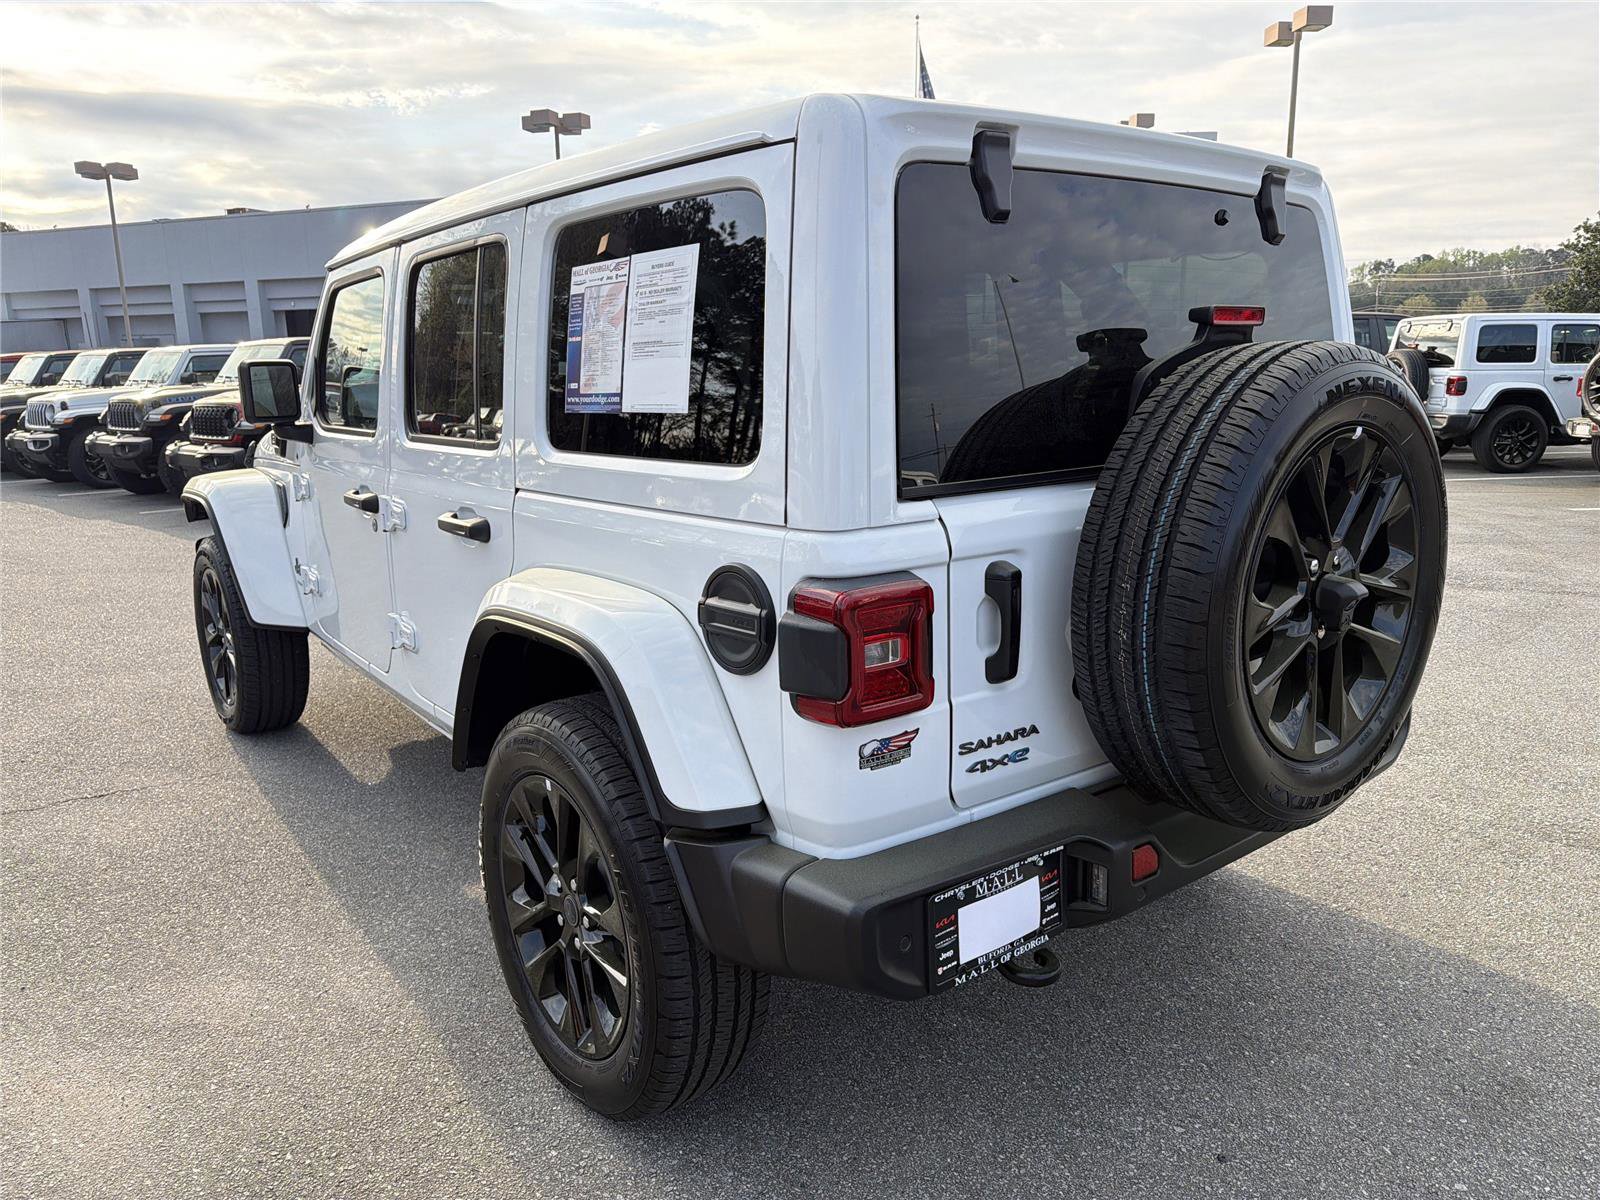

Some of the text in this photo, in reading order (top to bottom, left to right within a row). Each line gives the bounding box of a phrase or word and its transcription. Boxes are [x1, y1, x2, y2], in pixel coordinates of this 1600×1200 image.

[1326, 375, 1400, 402] NEXEN
[958, 724, 1040, 755] SAHARA
[935, 876, 985, 902] CHRYSLER
[989, 861, 1020, 879] DODGE
[939, 949, 954, 961] Jeep
[1000, 952, 1012, 964] OF
[1013, 934, 1050, 957] GEORGIA
